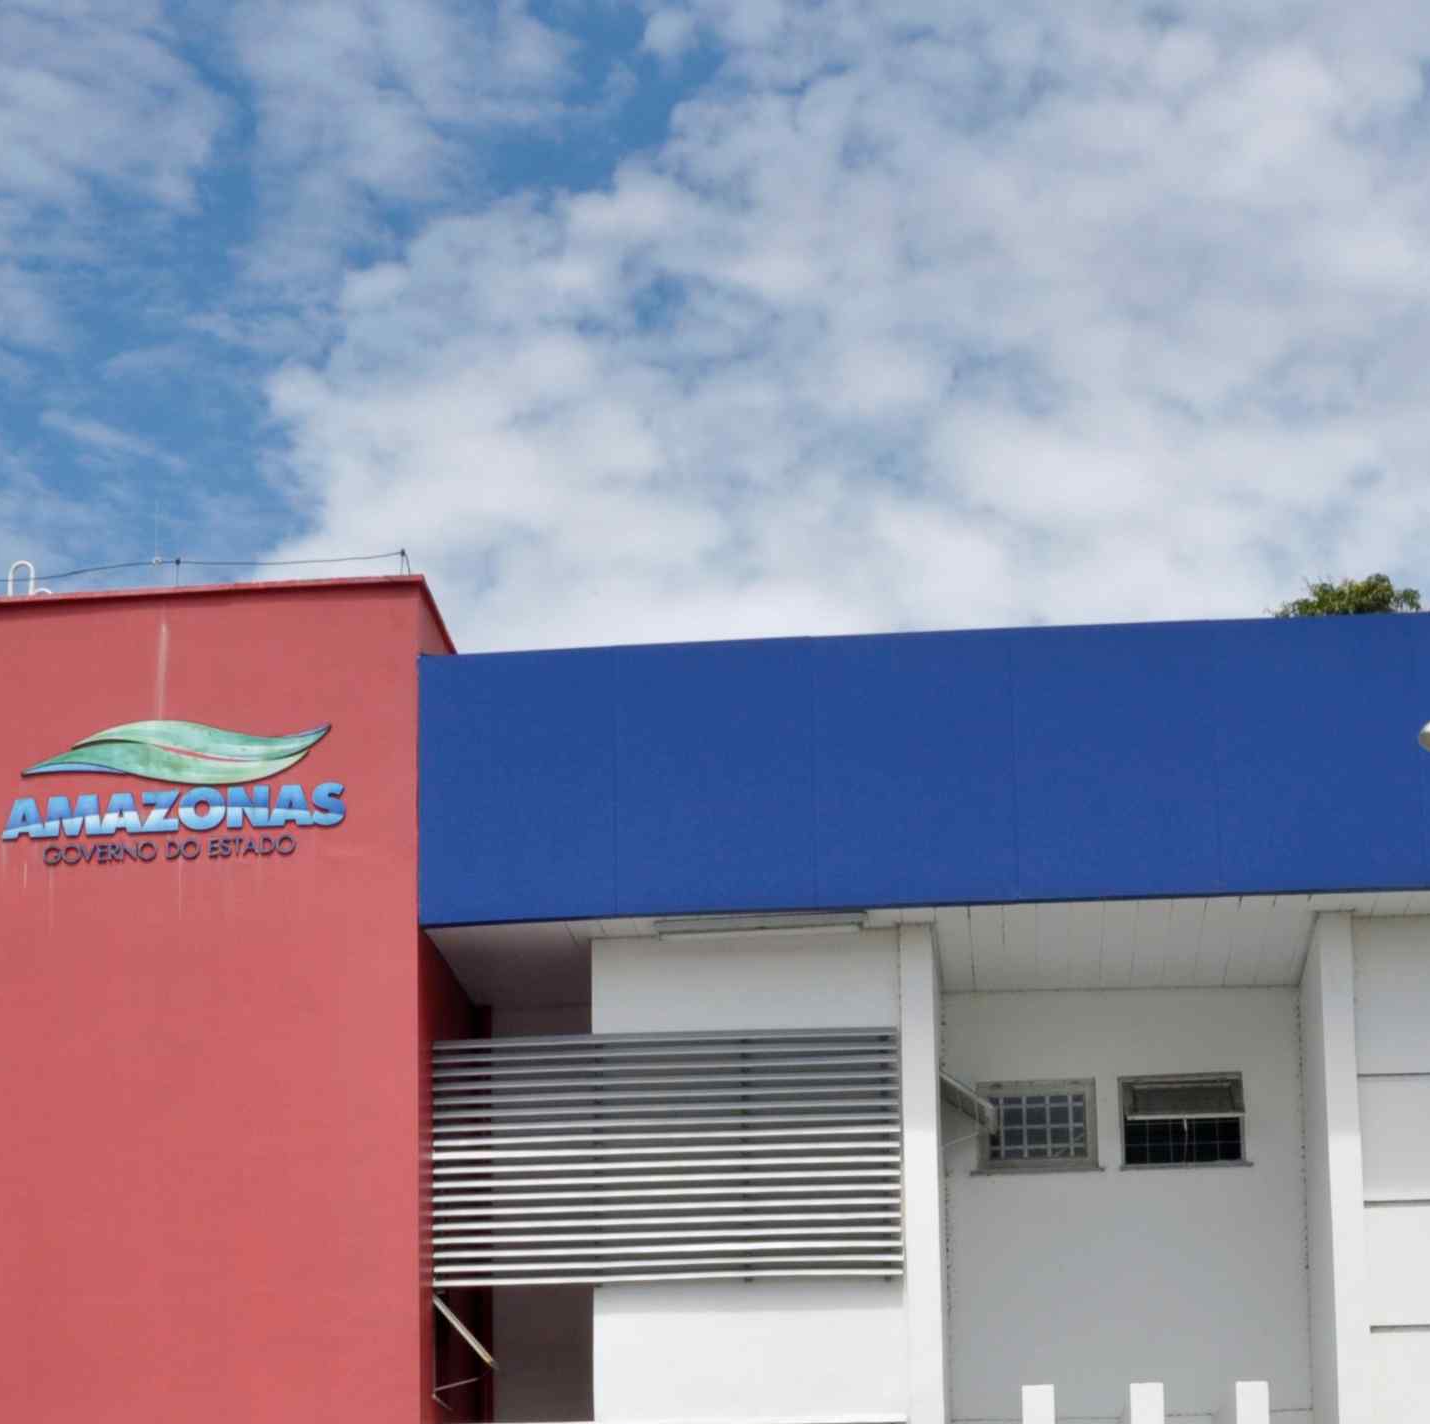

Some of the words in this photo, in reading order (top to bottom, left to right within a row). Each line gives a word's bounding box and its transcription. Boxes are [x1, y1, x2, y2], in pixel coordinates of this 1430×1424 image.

[0, 781, 346, 841] AMAZONAS
[42, 840, 158, 866] GOVERNO
[165, 838, 201, 860] DO
[208, 835, 297, 857] ESTADO
